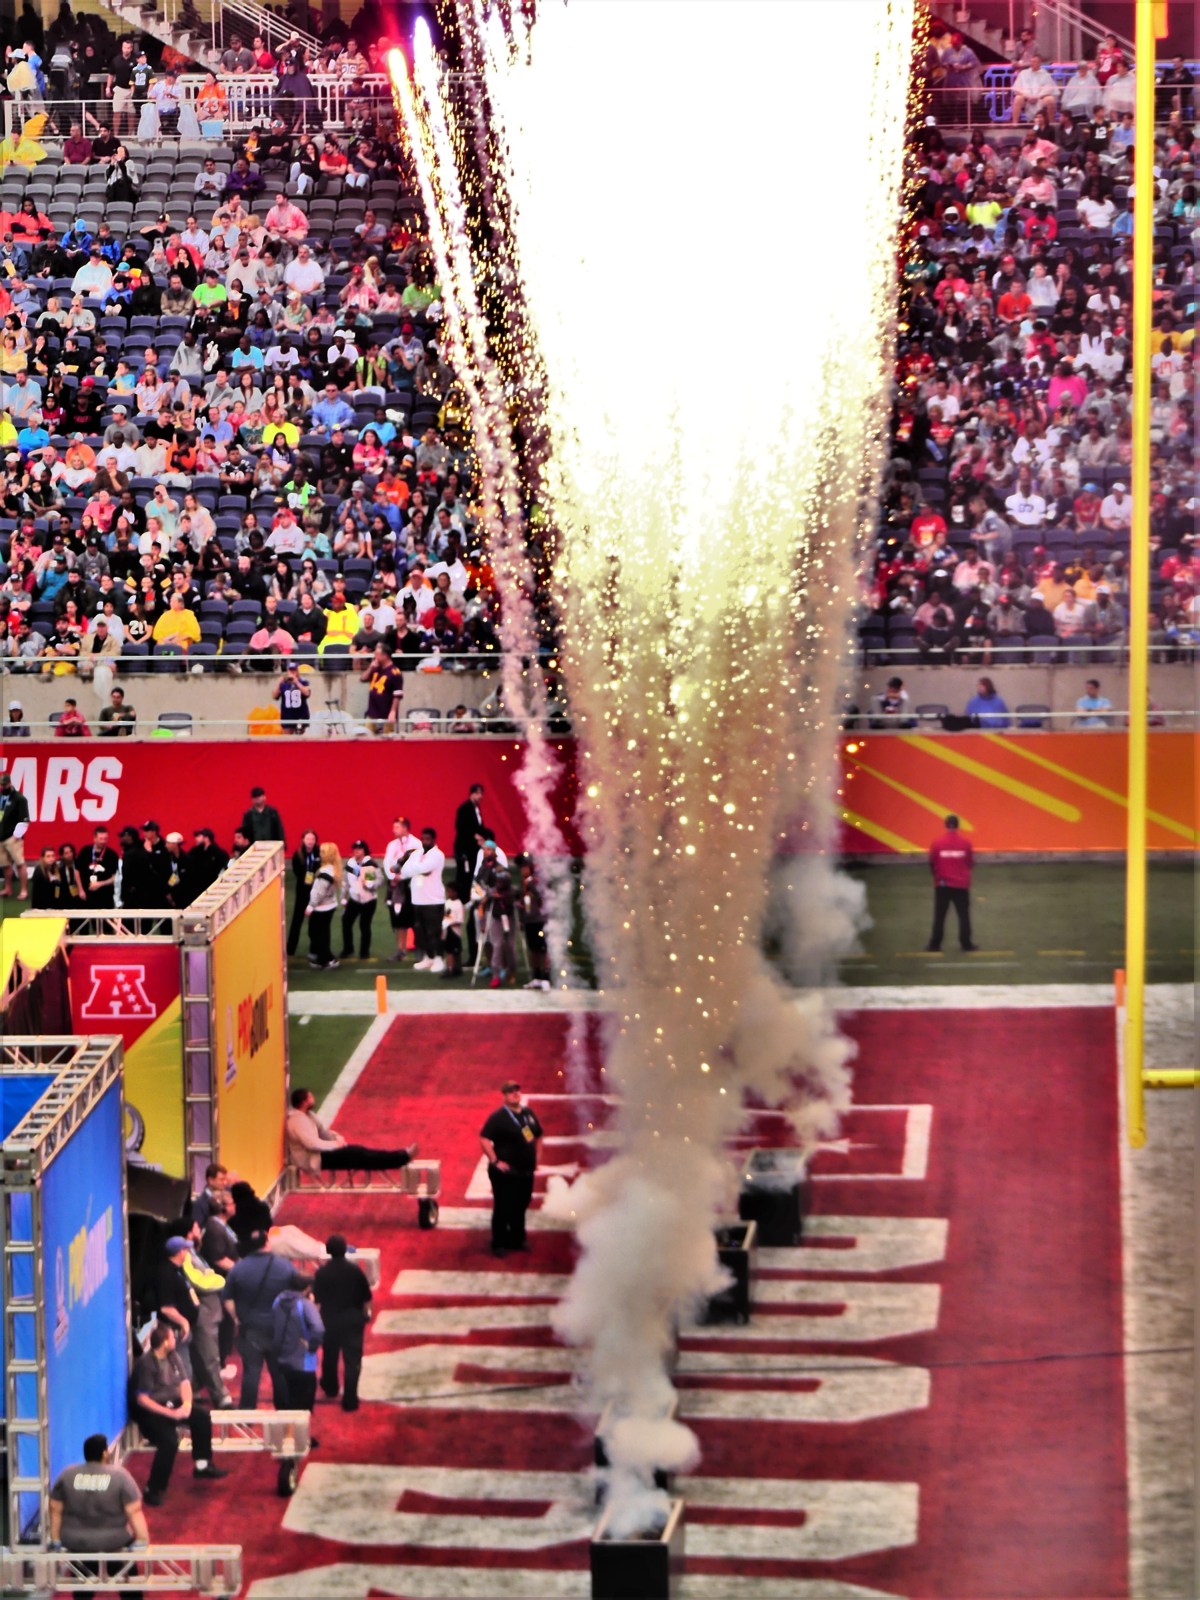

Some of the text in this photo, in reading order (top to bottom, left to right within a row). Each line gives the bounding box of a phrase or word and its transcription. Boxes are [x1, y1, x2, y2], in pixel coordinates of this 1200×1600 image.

[134, 72, 147, 86] 12
[201, 97, 219, 112] 23
[0, 756, 123, 822] ARS
[73, 1472, 111, 1492] CREW
